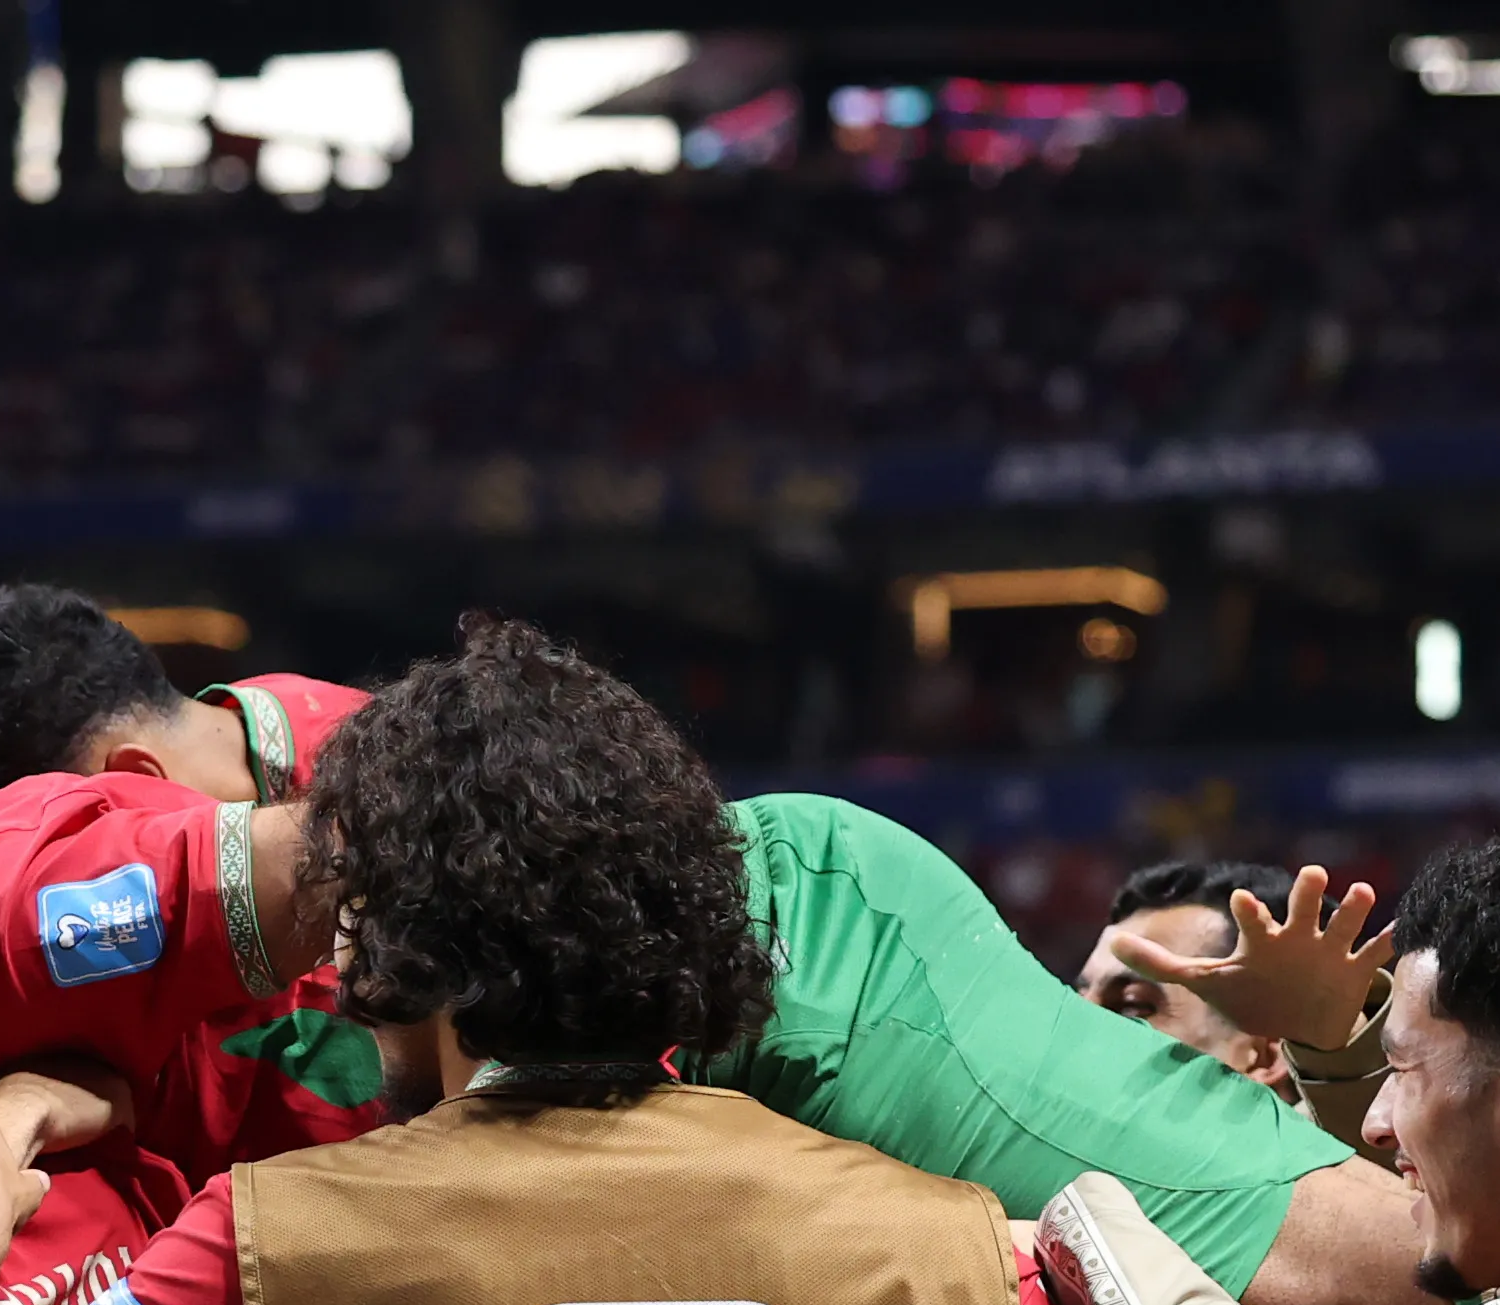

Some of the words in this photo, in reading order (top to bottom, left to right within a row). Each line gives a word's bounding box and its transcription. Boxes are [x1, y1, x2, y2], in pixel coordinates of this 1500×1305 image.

[986, 431, 1380, 502] ATLANTA
[112, 895, 137, 944] PEACE
[134, 899, 148, 930] FIFA
